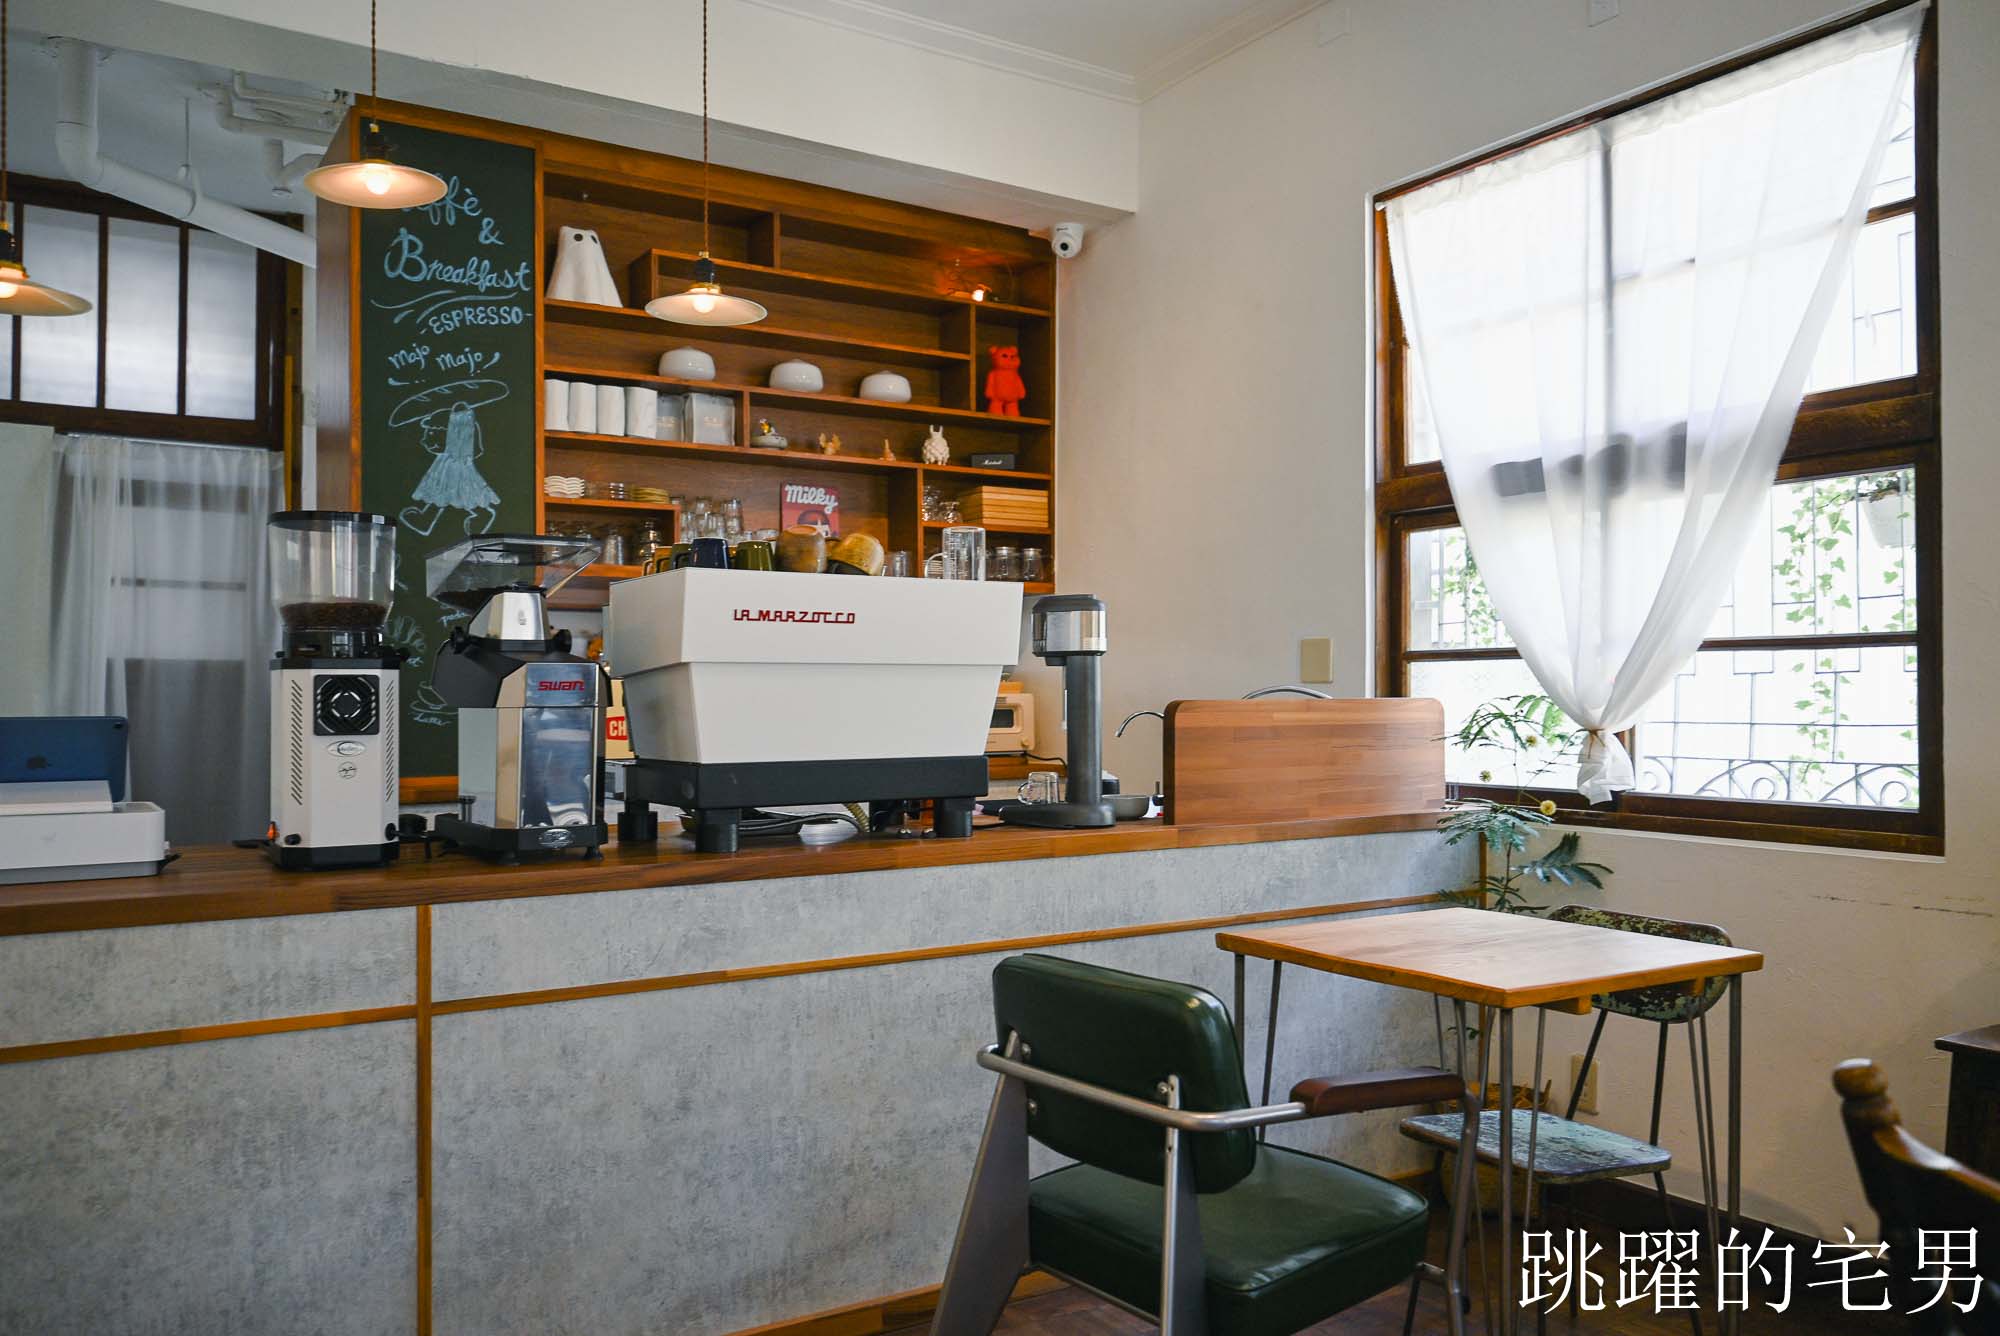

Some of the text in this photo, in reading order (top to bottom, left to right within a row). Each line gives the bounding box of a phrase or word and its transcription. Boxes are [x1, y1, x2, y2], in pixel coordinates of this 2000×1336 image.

[479, 217, 504, 245] &
[384, 227, 531, 292] Breakfast
[428, 306, 524, 335] ESPRESSO
[785, 484, 839, 515] Milky
